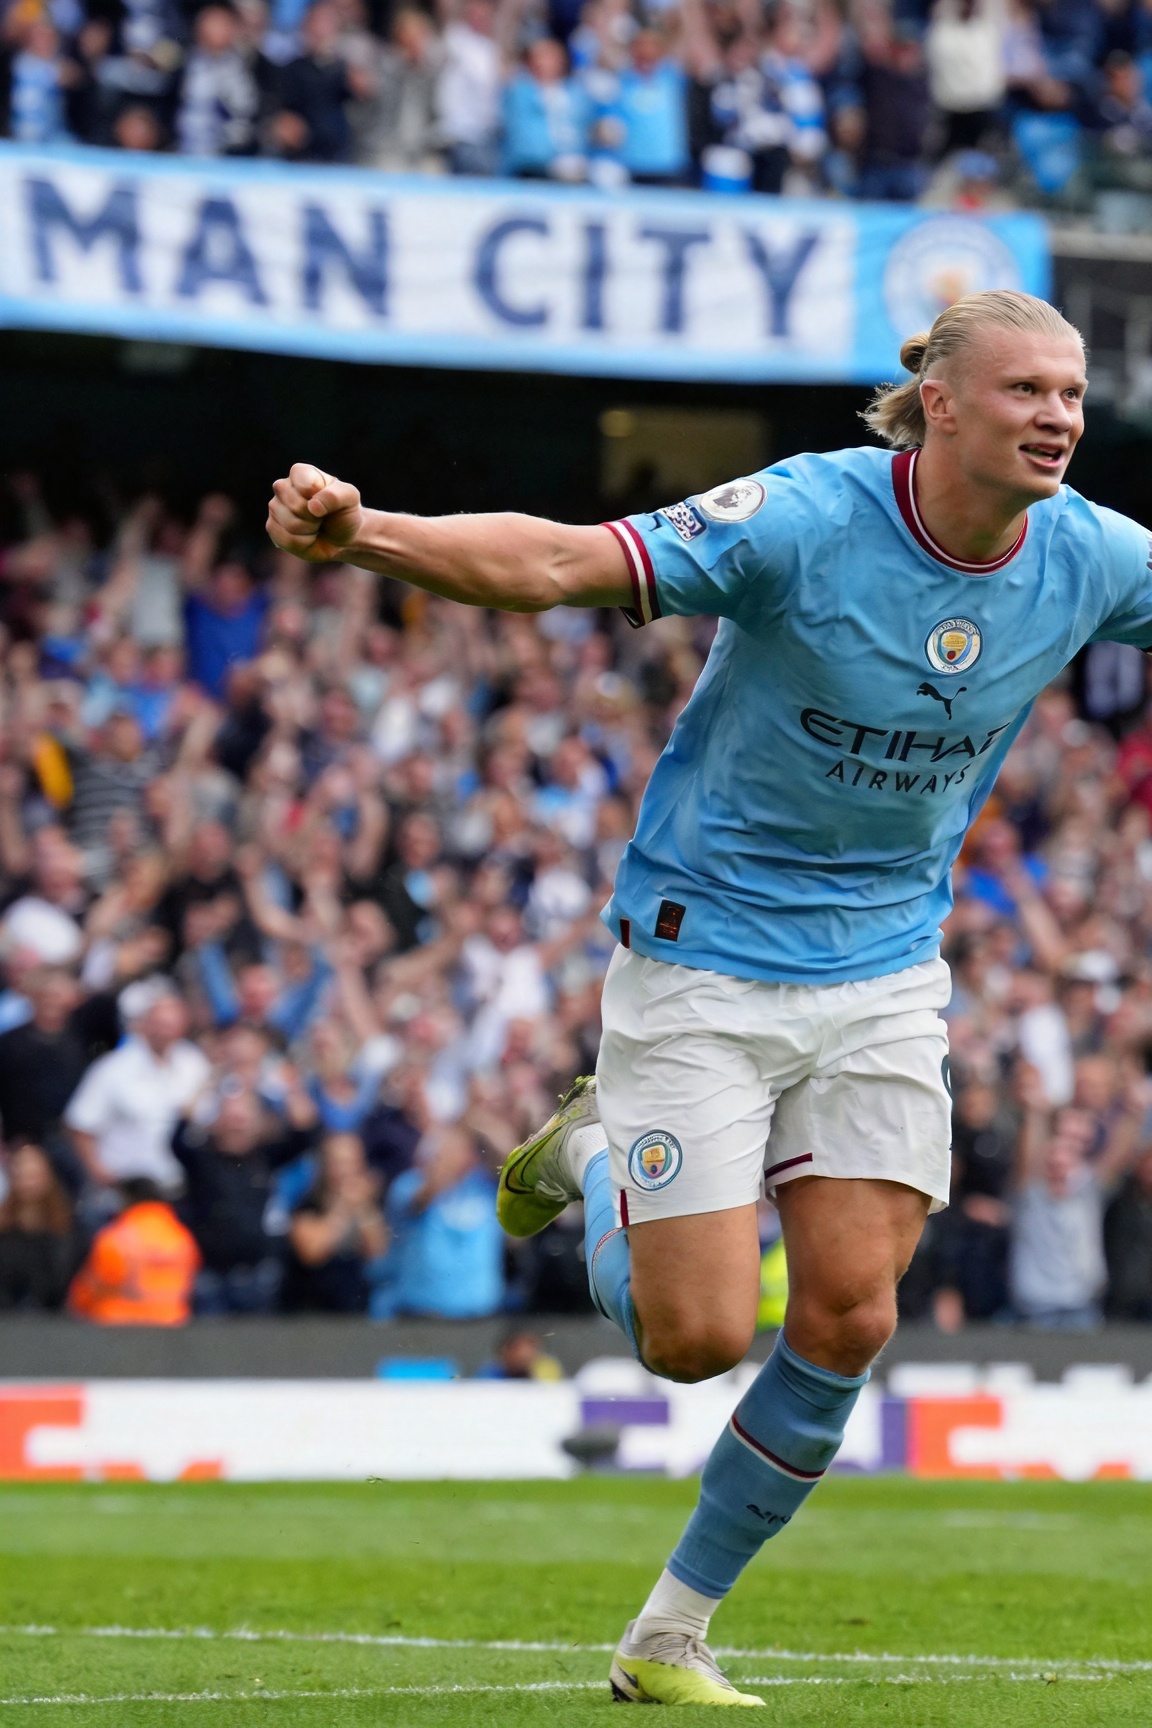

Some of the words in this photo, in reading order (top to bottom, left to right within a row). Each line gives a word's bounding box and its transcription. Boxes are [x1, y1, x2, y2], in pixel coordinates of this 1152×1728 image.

[22, 177, 391, 316] MAN
[474, 213, 824, 338] CITY
[825, 760, 971, 795] AIRWAYS
